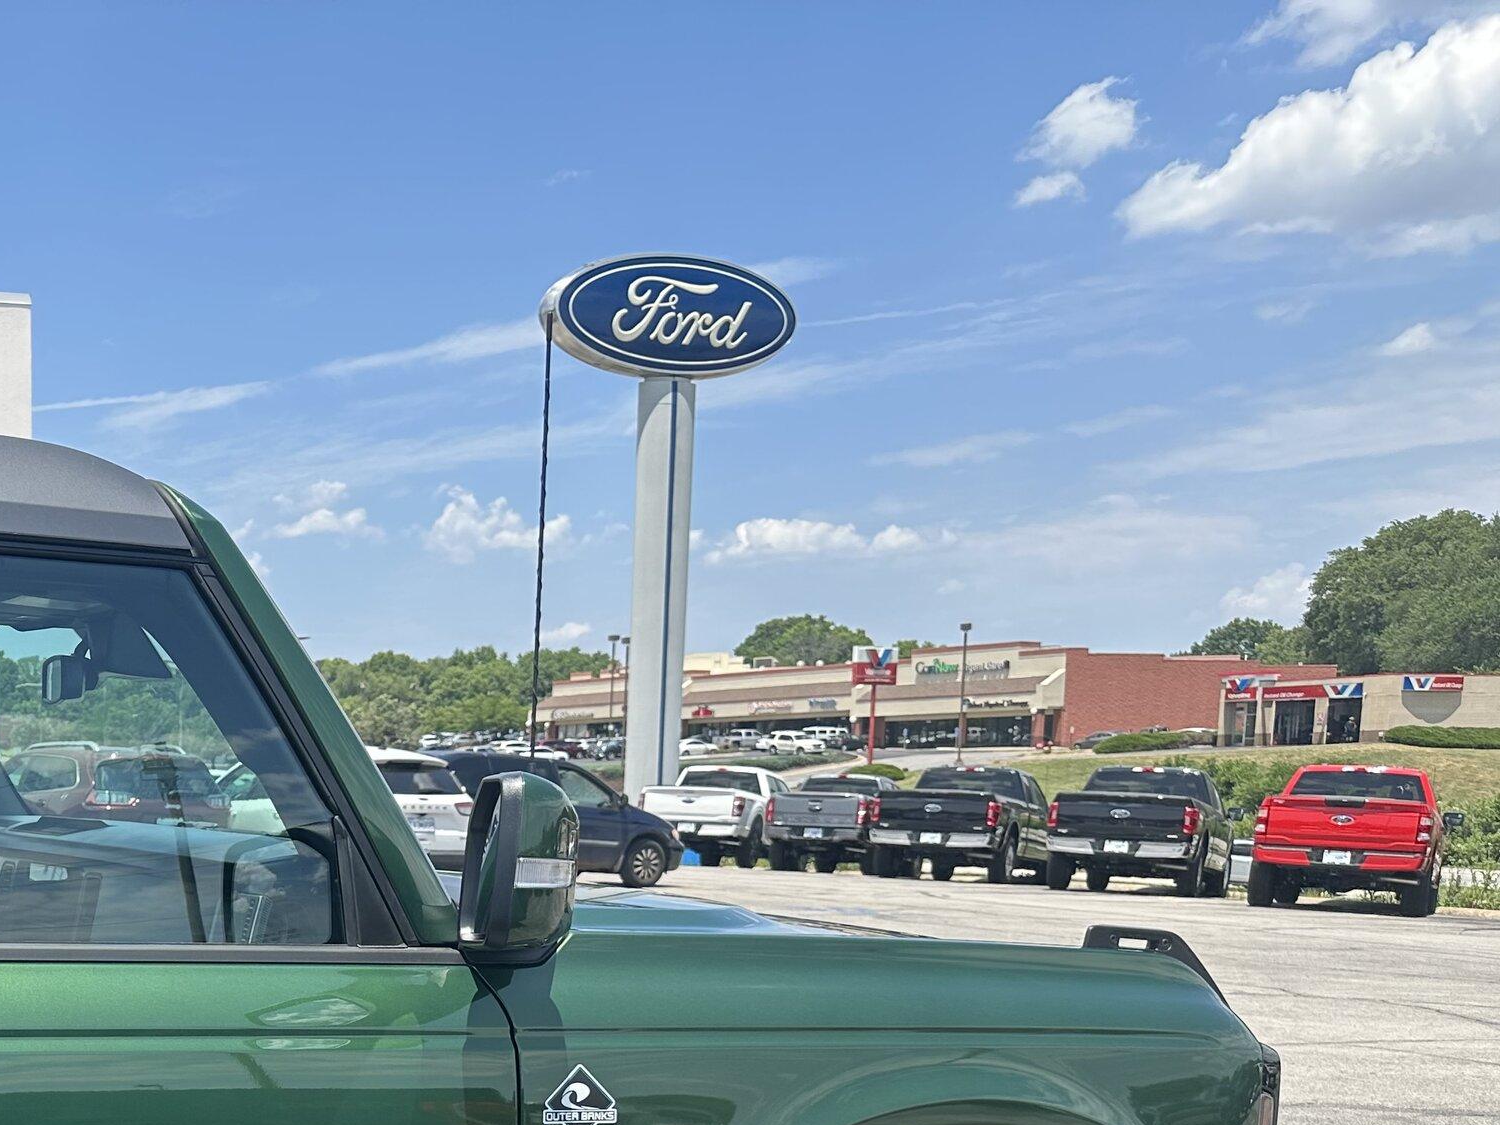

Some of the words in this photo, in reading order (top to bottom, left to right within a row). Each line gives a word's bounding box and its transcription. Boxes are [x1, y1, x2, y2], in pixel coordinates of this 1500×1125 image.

[611, 275, 753, 350] Ford
[546, 1112, 579, 1121] OUTER
[580, 1111, 614, 1121] BANKS
